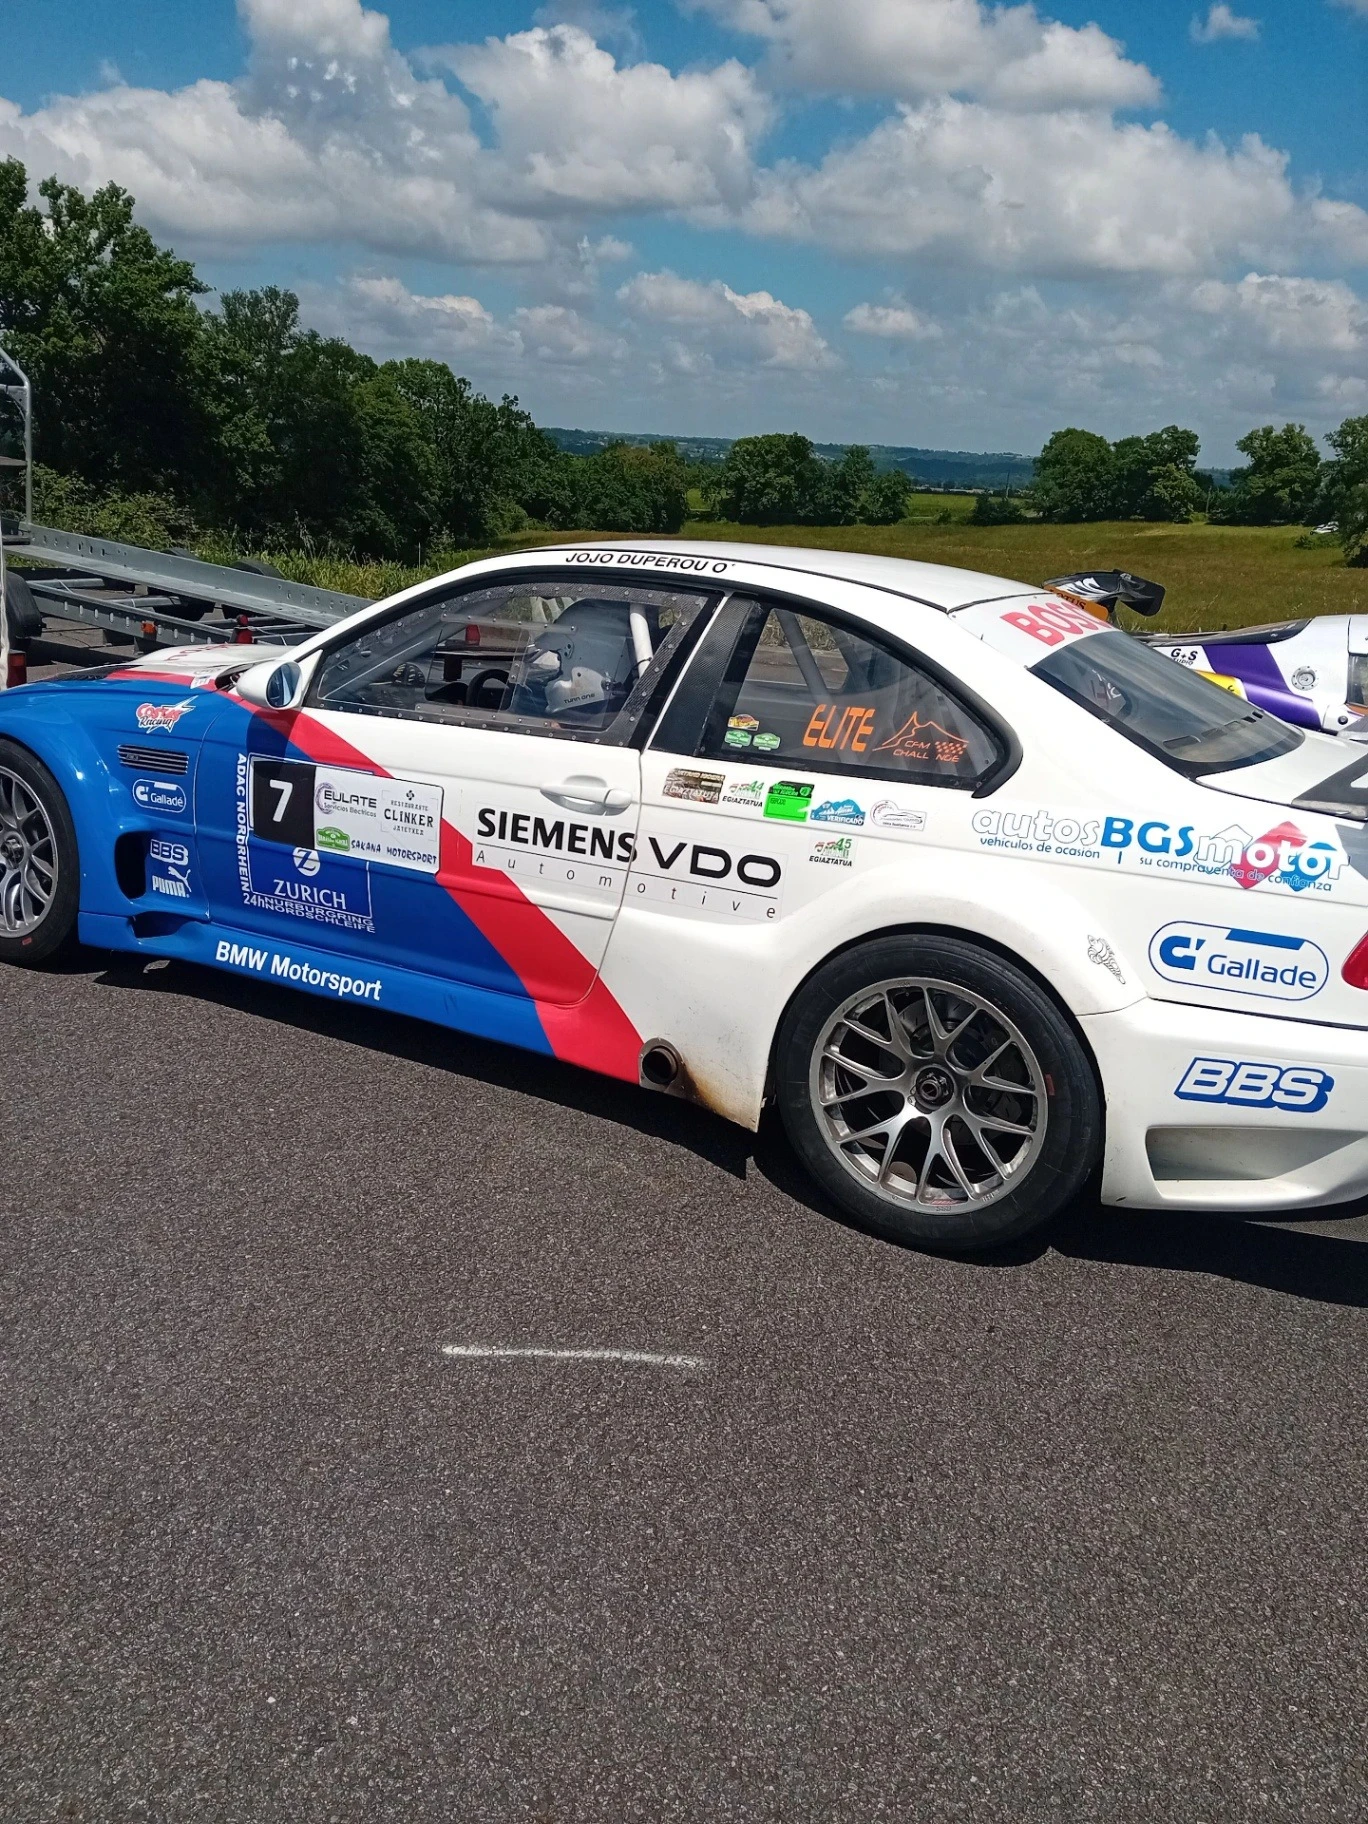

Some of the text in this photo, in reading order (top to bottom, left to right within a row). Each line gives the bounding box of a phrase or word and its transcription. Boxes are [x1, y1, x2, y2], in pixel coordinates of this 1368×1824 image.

[565, 552, 614, 564] JOJO
[617, 554, 709, 571] DUPEROU
[802, 703, 876, 752] ELITE
[269, 779, 294, 823] 7
[324, 789, 377, 809] EULATE
[722, 795, 763, 808] EGIAZTATUA
[236, 753, 250, 891] ADAC NORDRHEIN
[150, 839, 188, 866] BBS
[351, 840, 437, 865] SAKANA MOTORSPORT
[476, 807, 782, 888] SIEMENS VDO
[808, 855, 852, 867] EGIAZTATUA
[980, 836, 1100, 859] vehículos de ocasión
[152, 875, 187, 898] PUMA
[1139, 857, 1332, 892] su compraventa de confianza
[273, 879, 347, 910] ZURICH
[264, 903, 376, 934] NORDSCHLEIFE
[215, 940, 383, 1001] BMW Motorsport
[1207, 953, 1317, 990] Gallade
[1173, 1057, 1335, 1113] BBS
